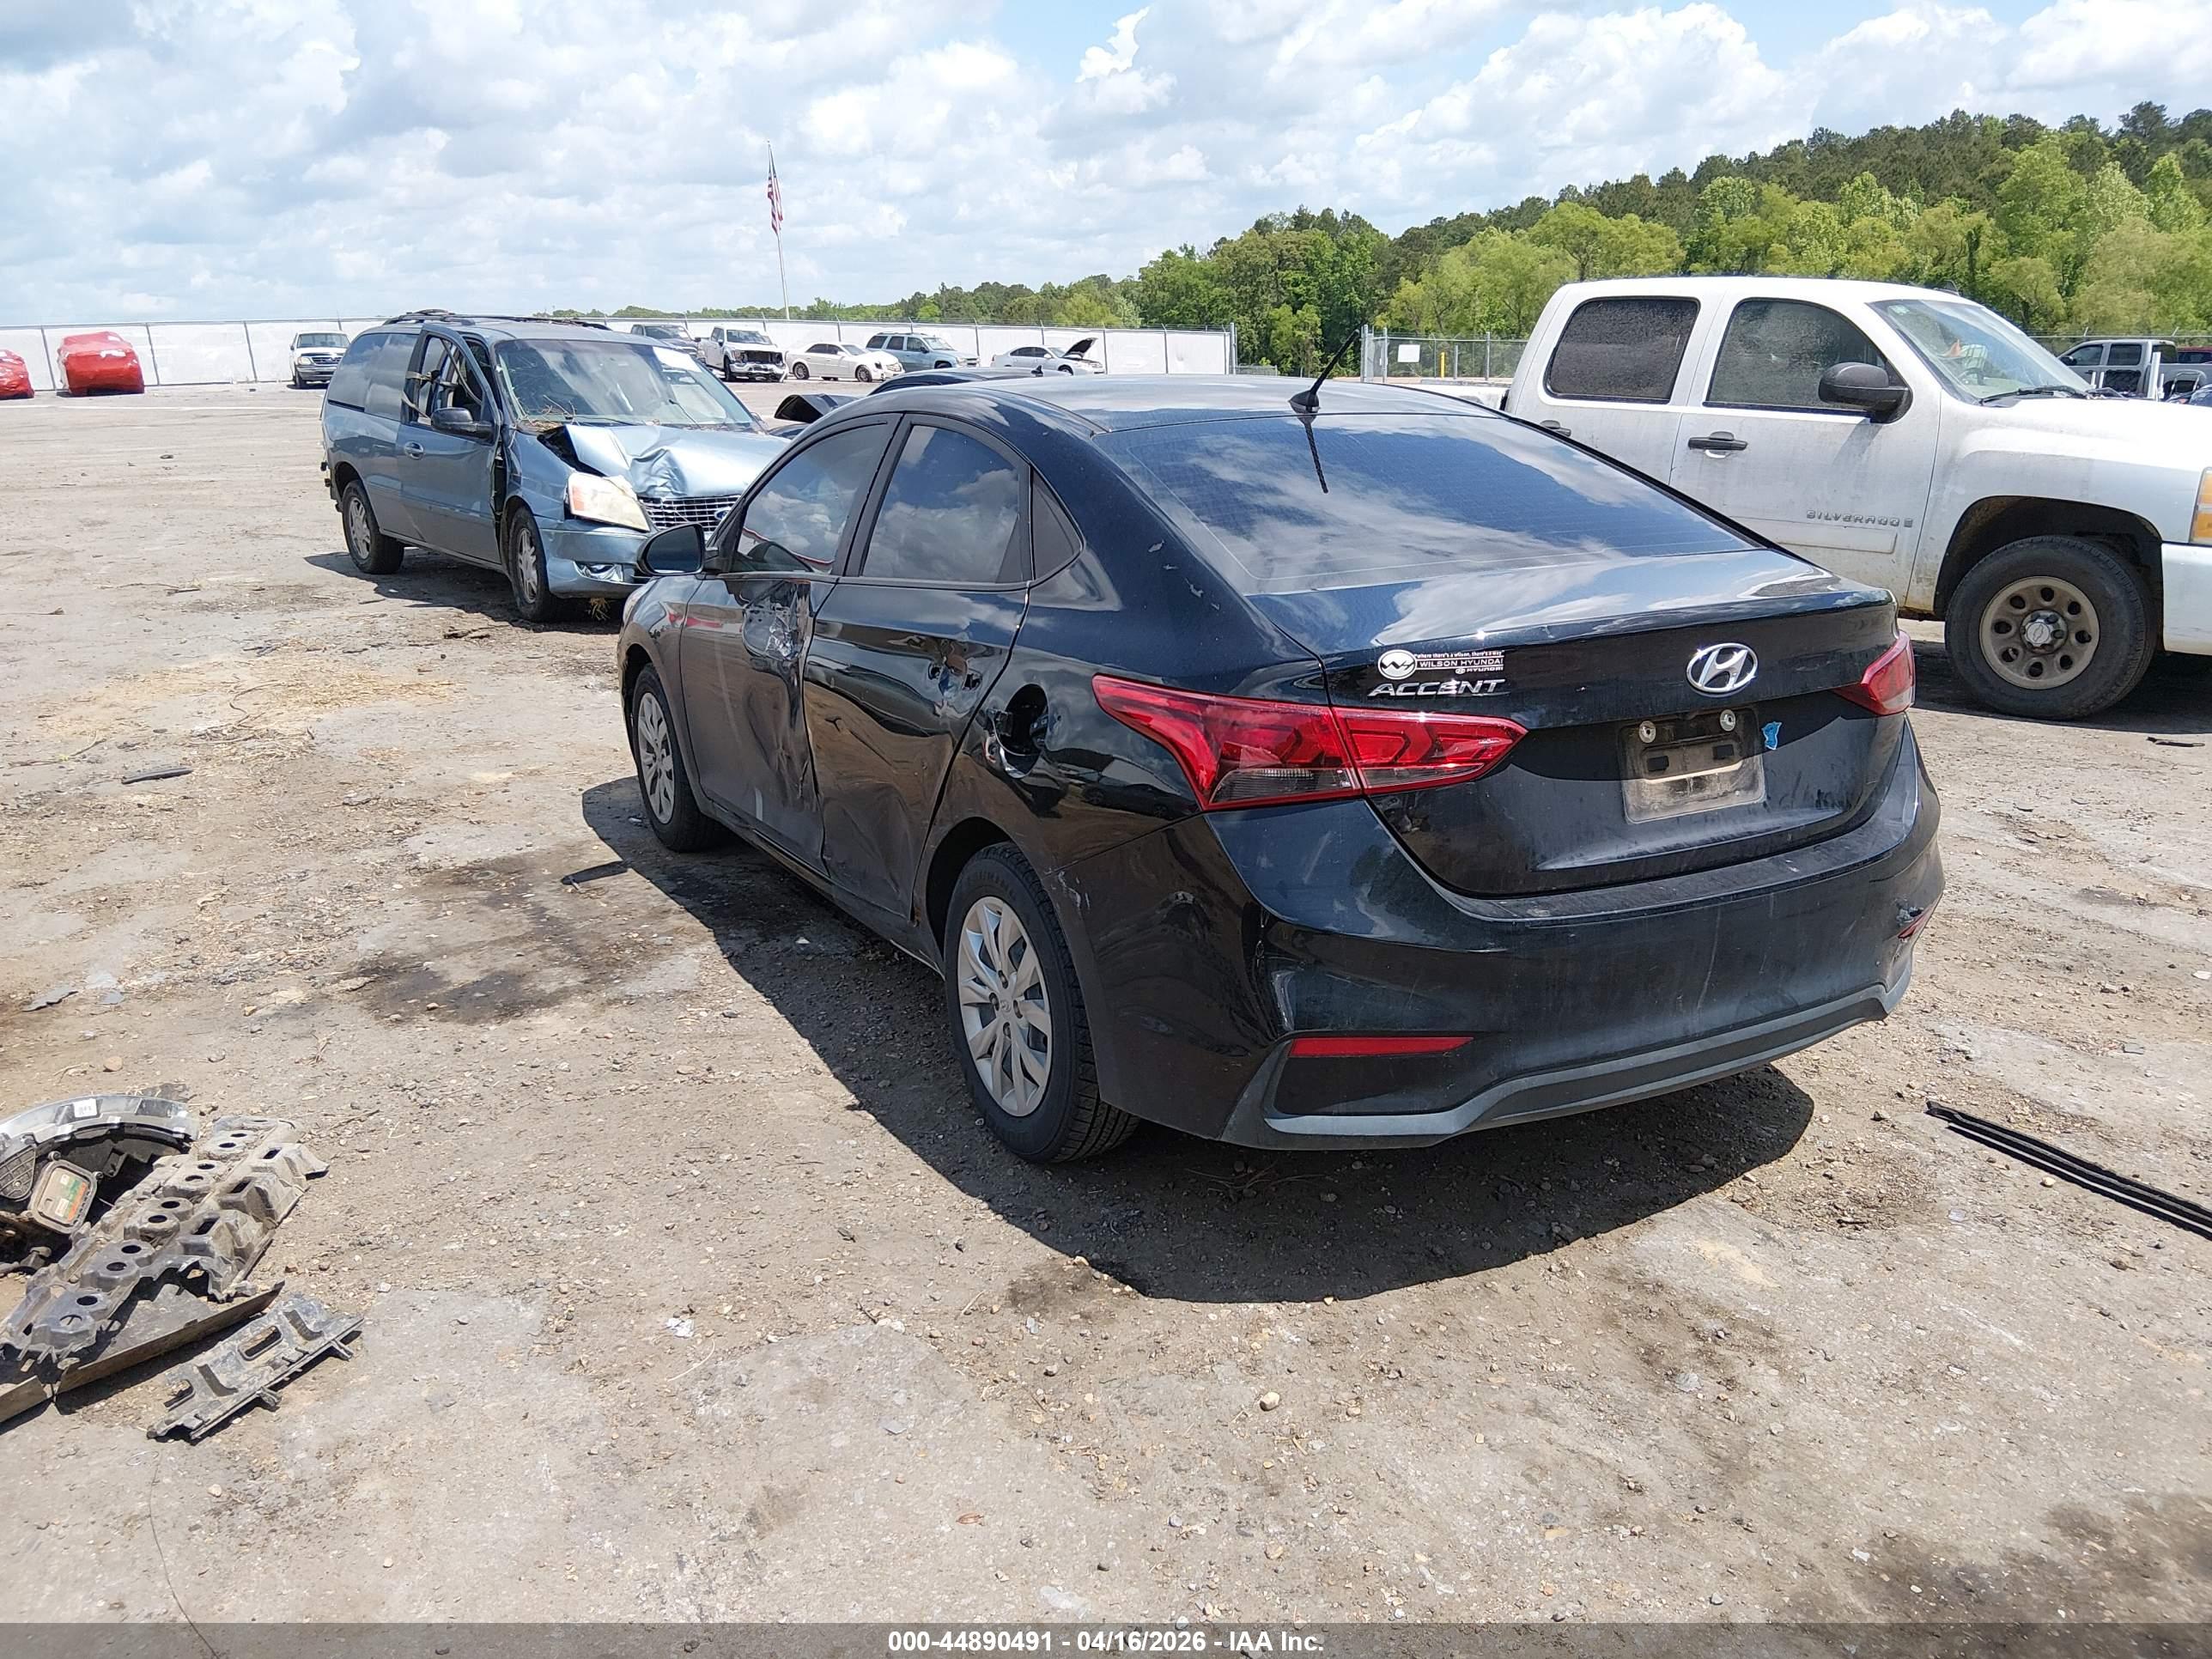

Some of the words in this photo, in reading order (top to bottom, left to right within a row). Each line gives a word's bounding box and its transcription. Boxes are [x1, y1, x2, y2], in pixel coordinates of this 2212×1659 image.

[1806, 509, 1900, 527] SILVERADO
[1419, 659, 1458, 668] WILSON
[1461, 658, 1504, 666] HYUNDAI
[1366, 678, 1506, 697] ACCENT
